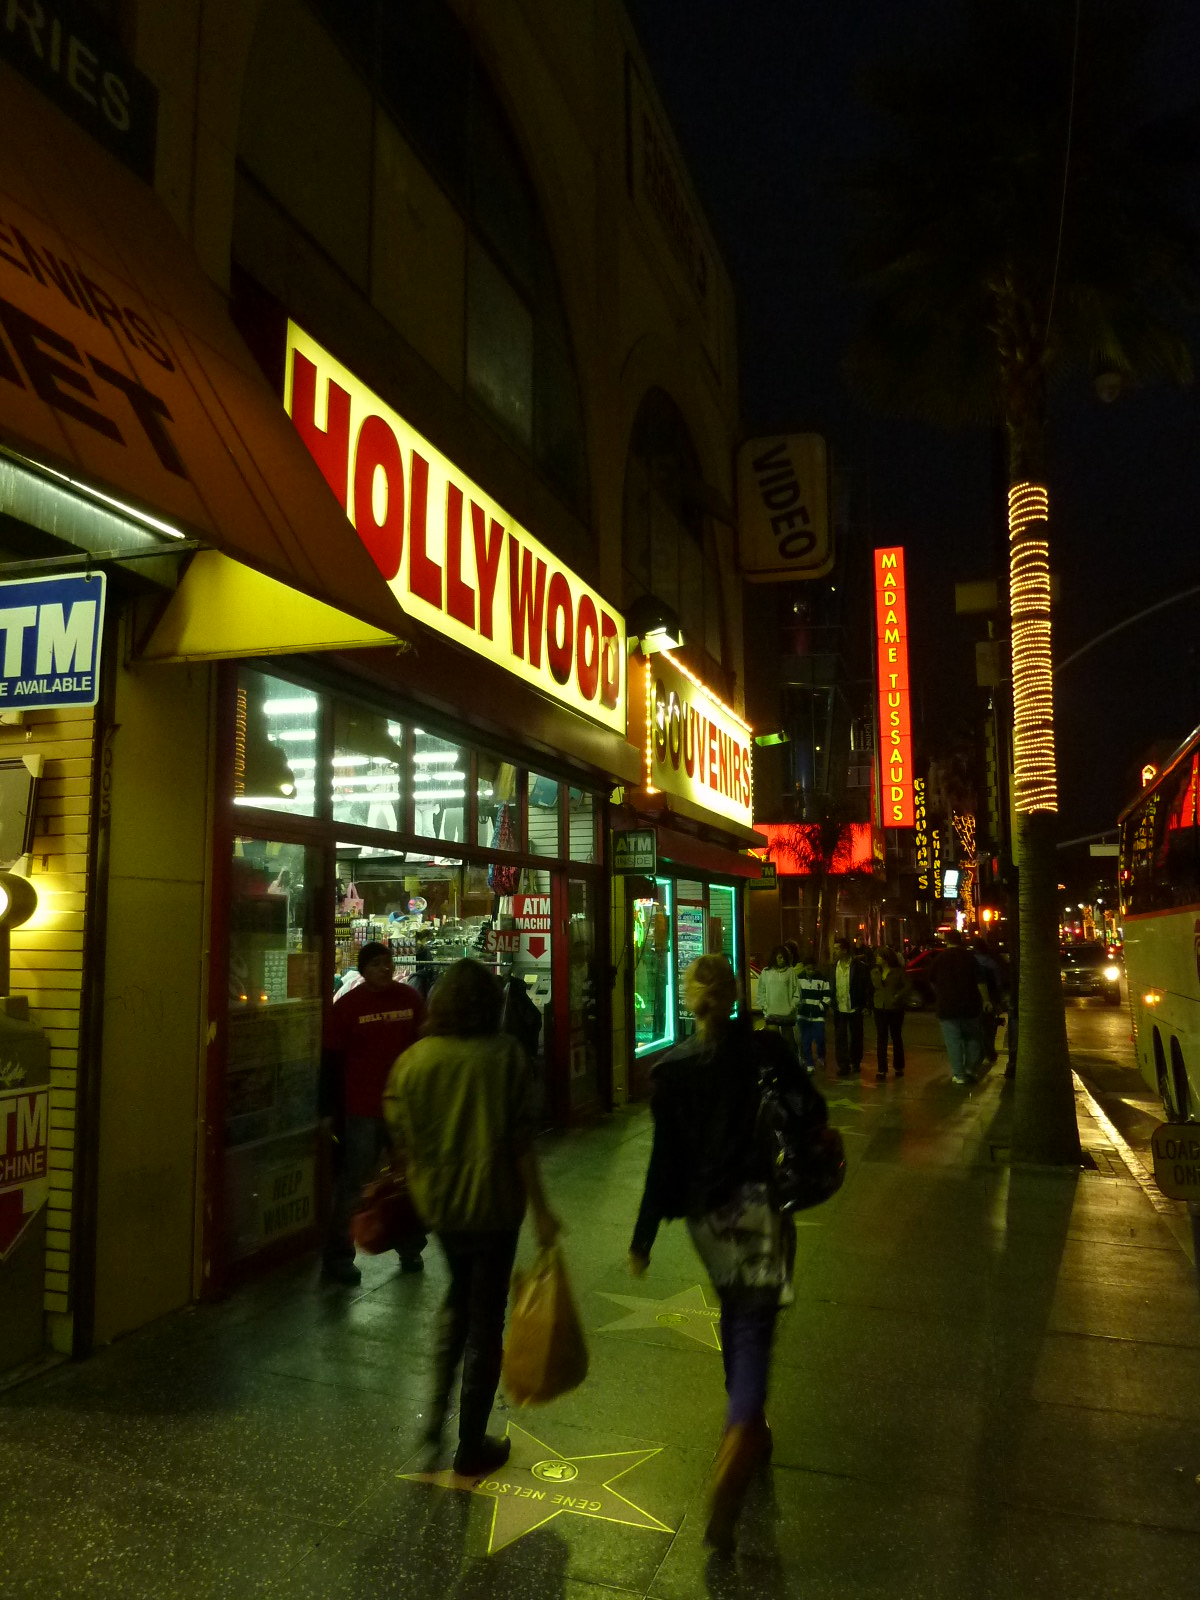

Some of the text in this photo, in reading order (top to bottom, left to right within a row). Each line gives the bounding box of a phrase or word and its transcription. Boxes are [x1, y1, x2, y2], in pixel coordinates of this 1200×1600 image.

[752, 443, 817, 559] VIDEO
[290, 346, 619, 712] HOLLYWOOD
[14, 676, 92, 696] AVAILABLE
[880, 553, 905, 821] MADAME TUSSAUDS
[654, 678, 750, 809] SOUVENIRS
[616, 834, 651, 852] ATM
[615, 855, 650, 866] INSIDE
[932, 829, 942, 899] CHINESE
[522, 897, 551, 915] ATM
[486, 930, 520, 952] SALE
[549, 1493, 602, 1512] GENE
